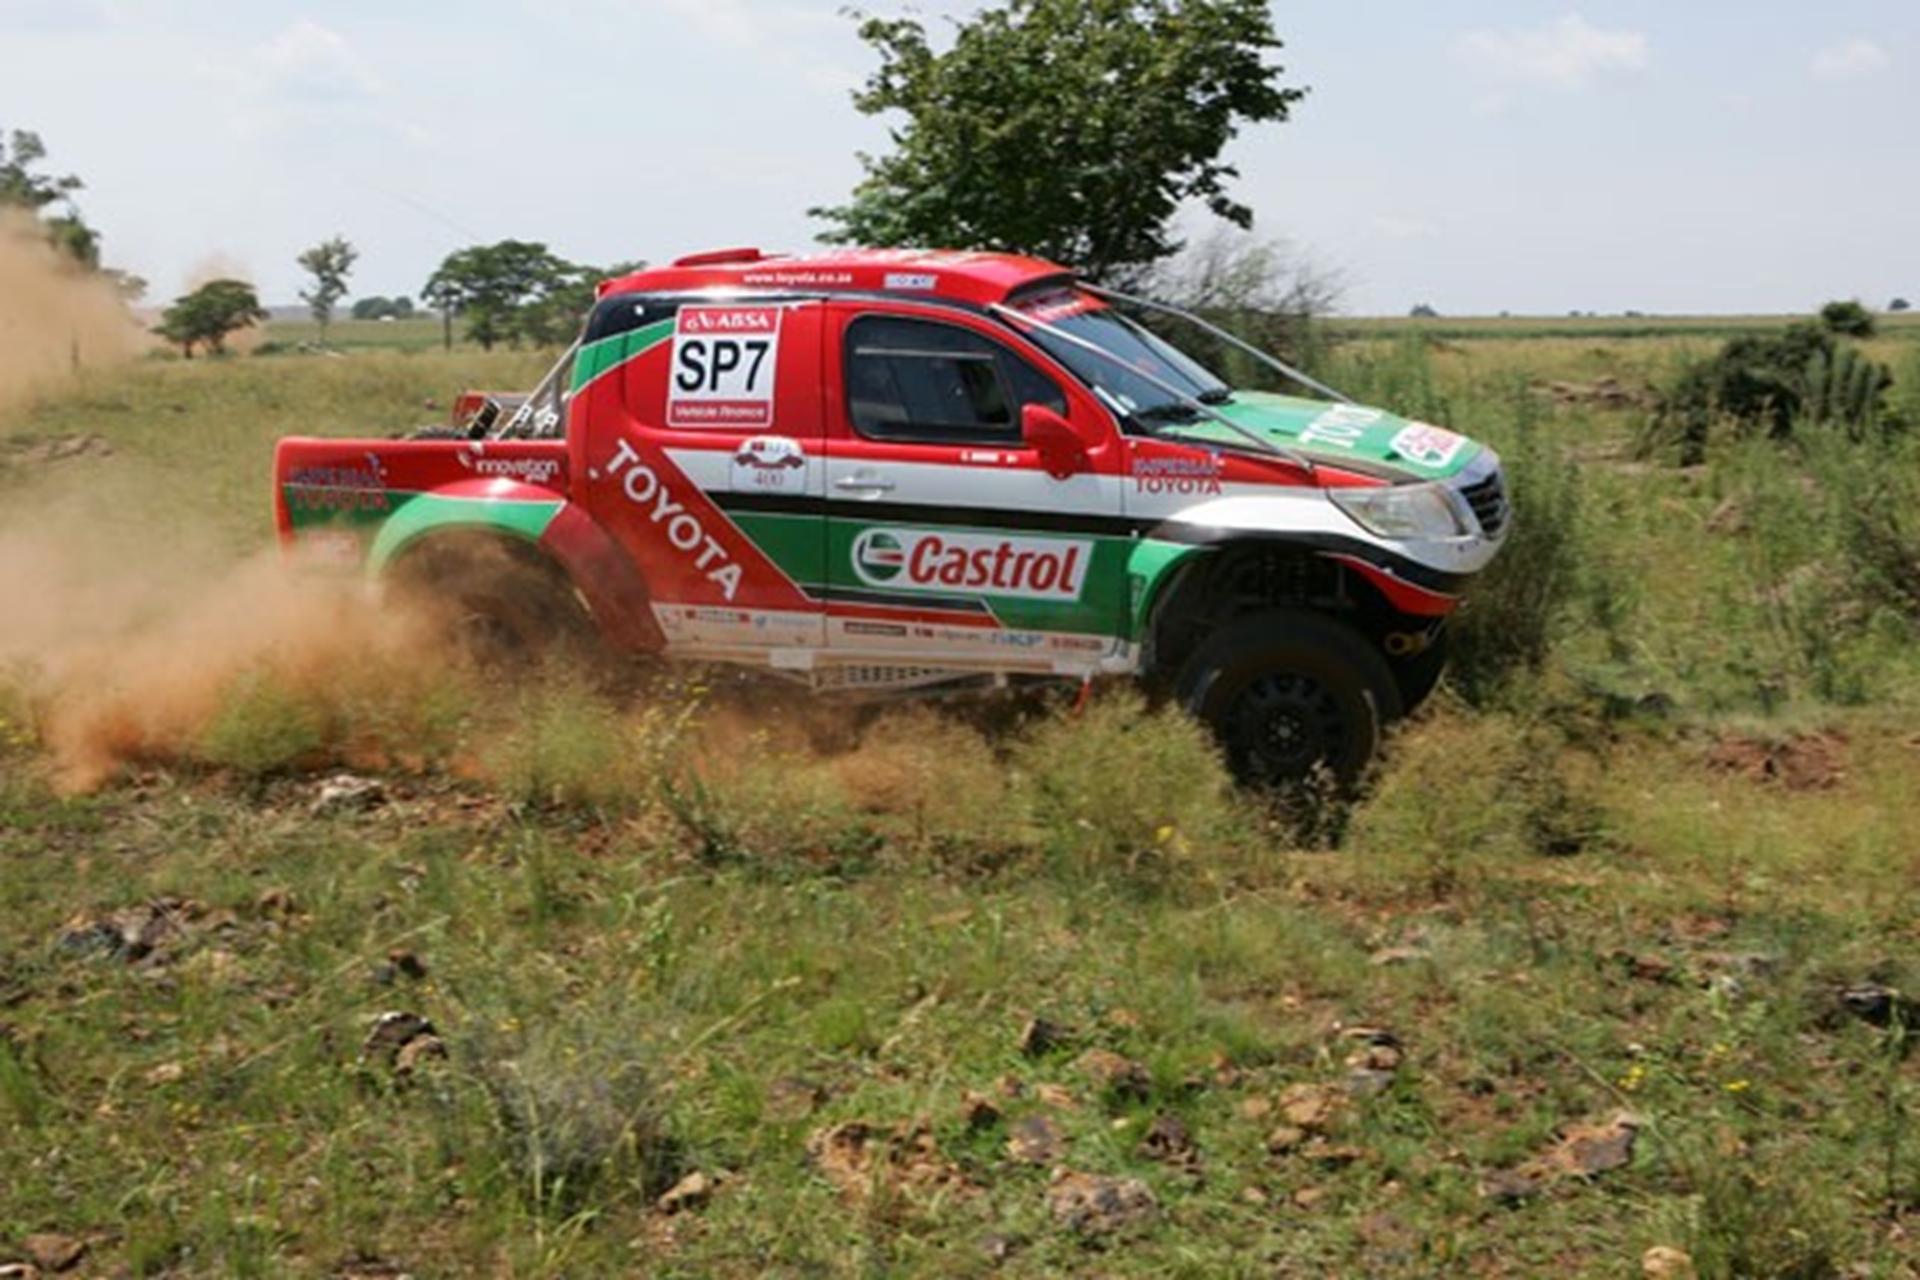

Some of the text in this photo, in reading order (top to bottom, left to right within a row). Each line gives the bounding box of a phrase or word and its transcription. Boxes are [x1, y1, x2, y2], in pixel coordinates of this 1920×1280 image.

[718, 312, 769, 328] ABSA
[676, 340, 769, 392] SP7
[1136, 474, 1222, 495] TOYOTA
[606, 437, 743, 602] TOYOTA
[908, 534, 1080, 594] Castrol
